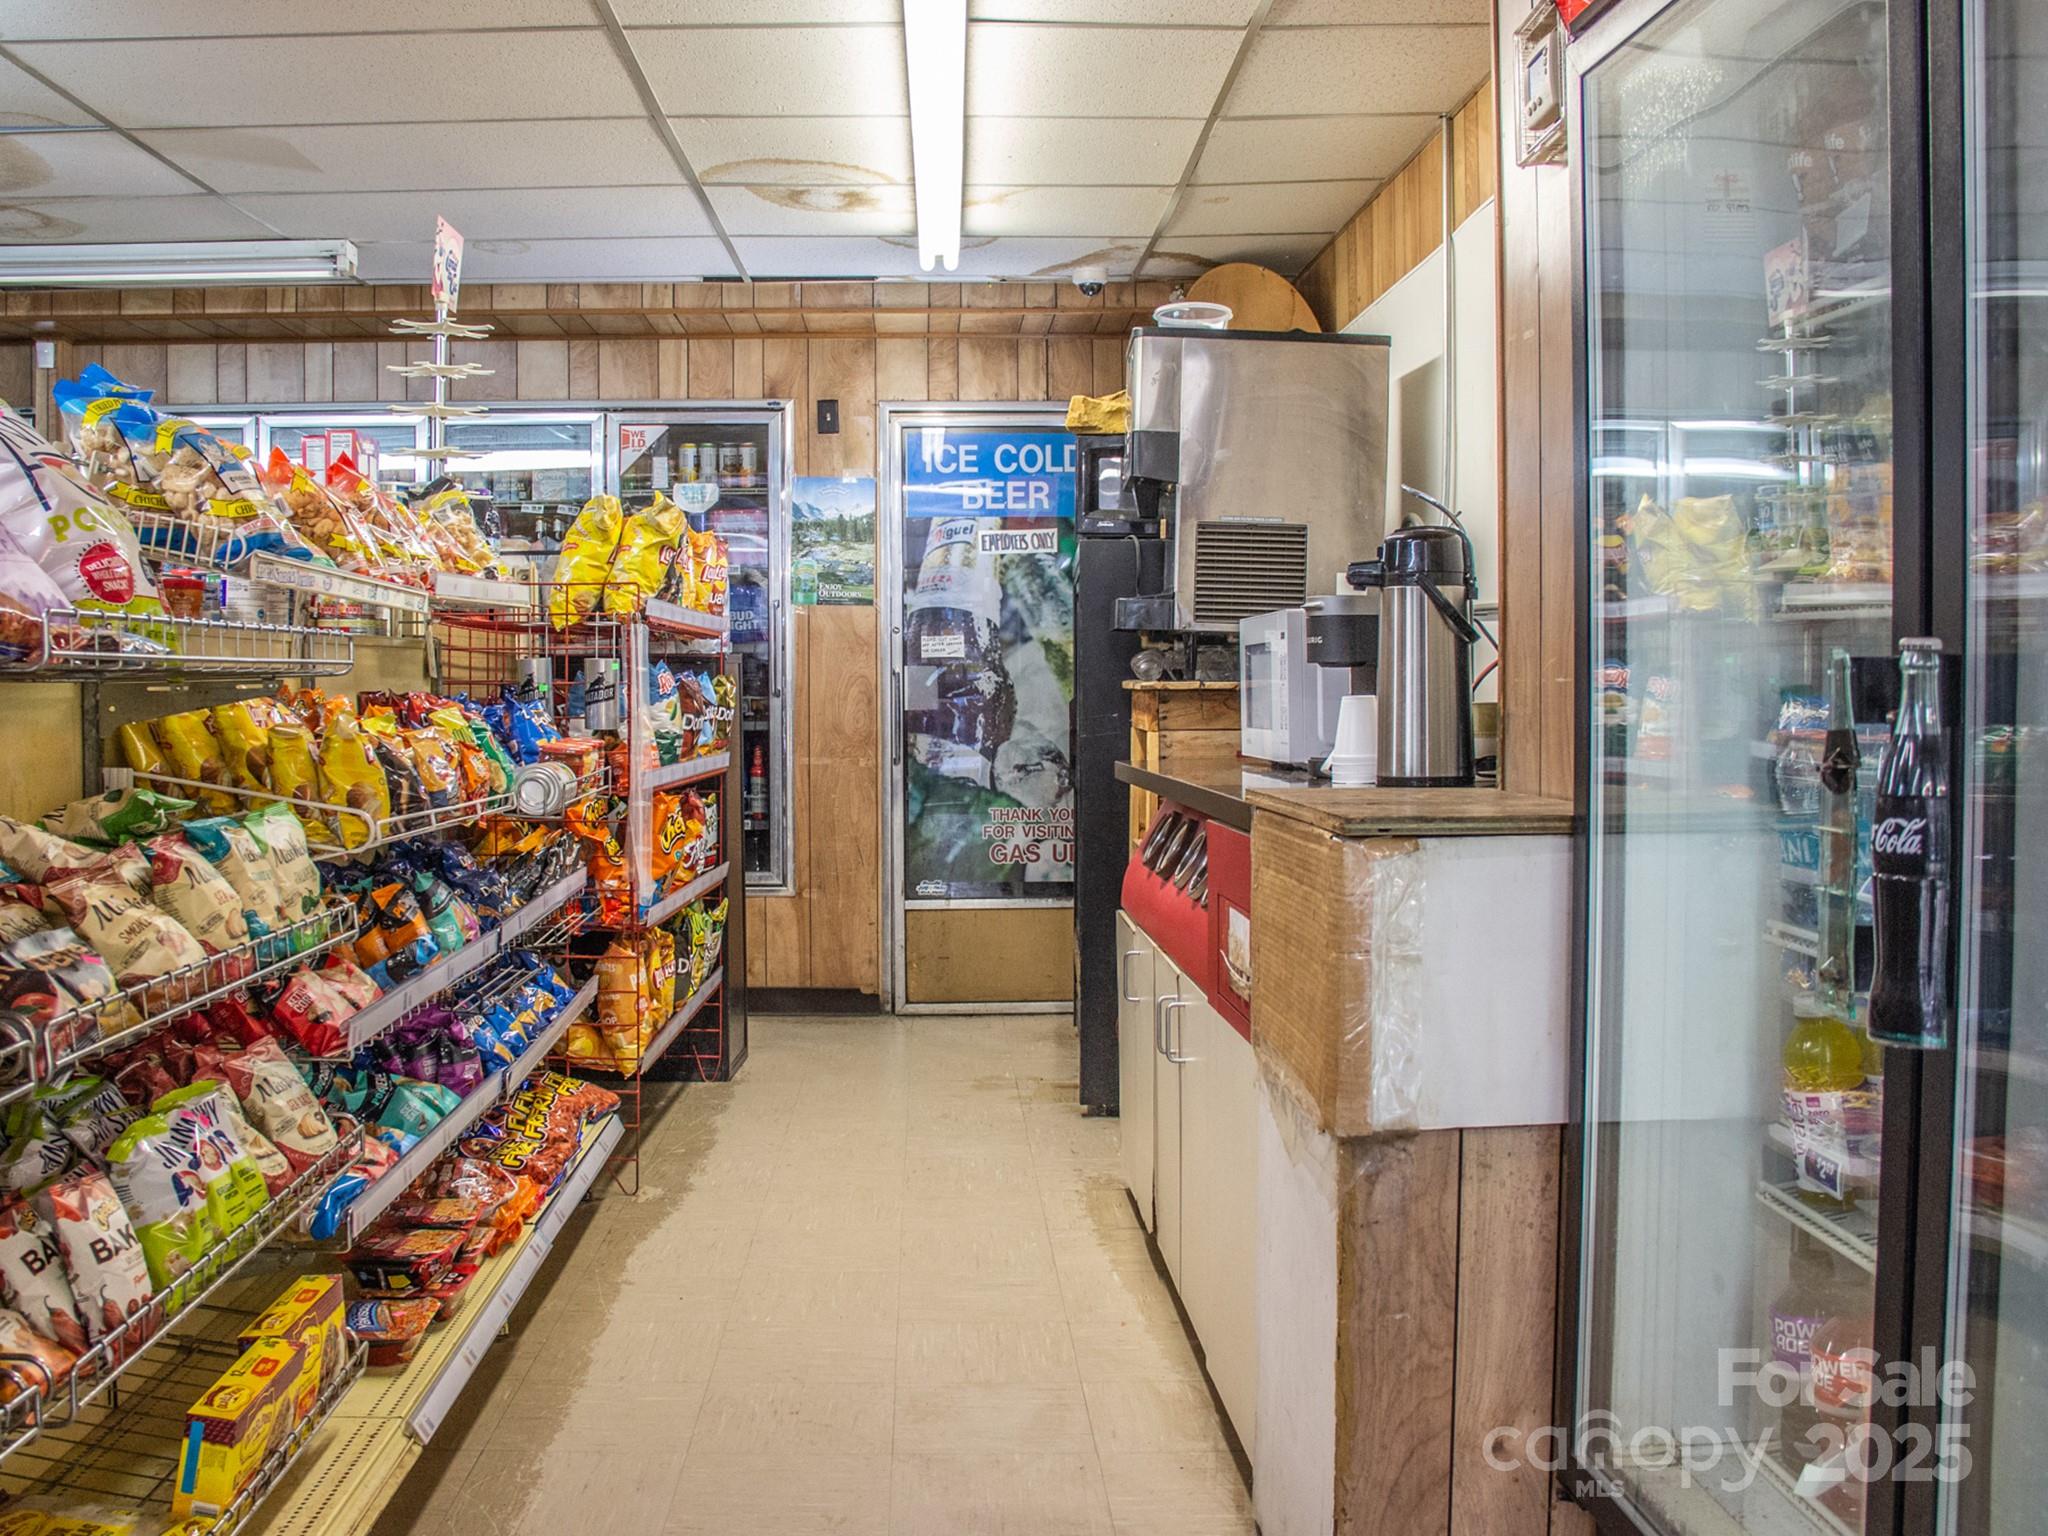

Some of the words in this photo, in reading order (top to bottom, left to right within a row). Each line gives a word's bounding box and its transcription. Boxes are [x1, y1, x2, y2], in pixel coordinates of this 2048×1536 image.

[631, 430, 646, 439] WE
[924, 444, 979, 474] ICE
[961, 480, 1050, 510] BEER
[1030, 531, 1056, 550] ONLY
[990, 808, 1042, 822] THANK
[982, 825, 1015, 839] FOR
[1022, 825, 1075, 839] VISITIN
[990, 843, 1041, 864] GAS
